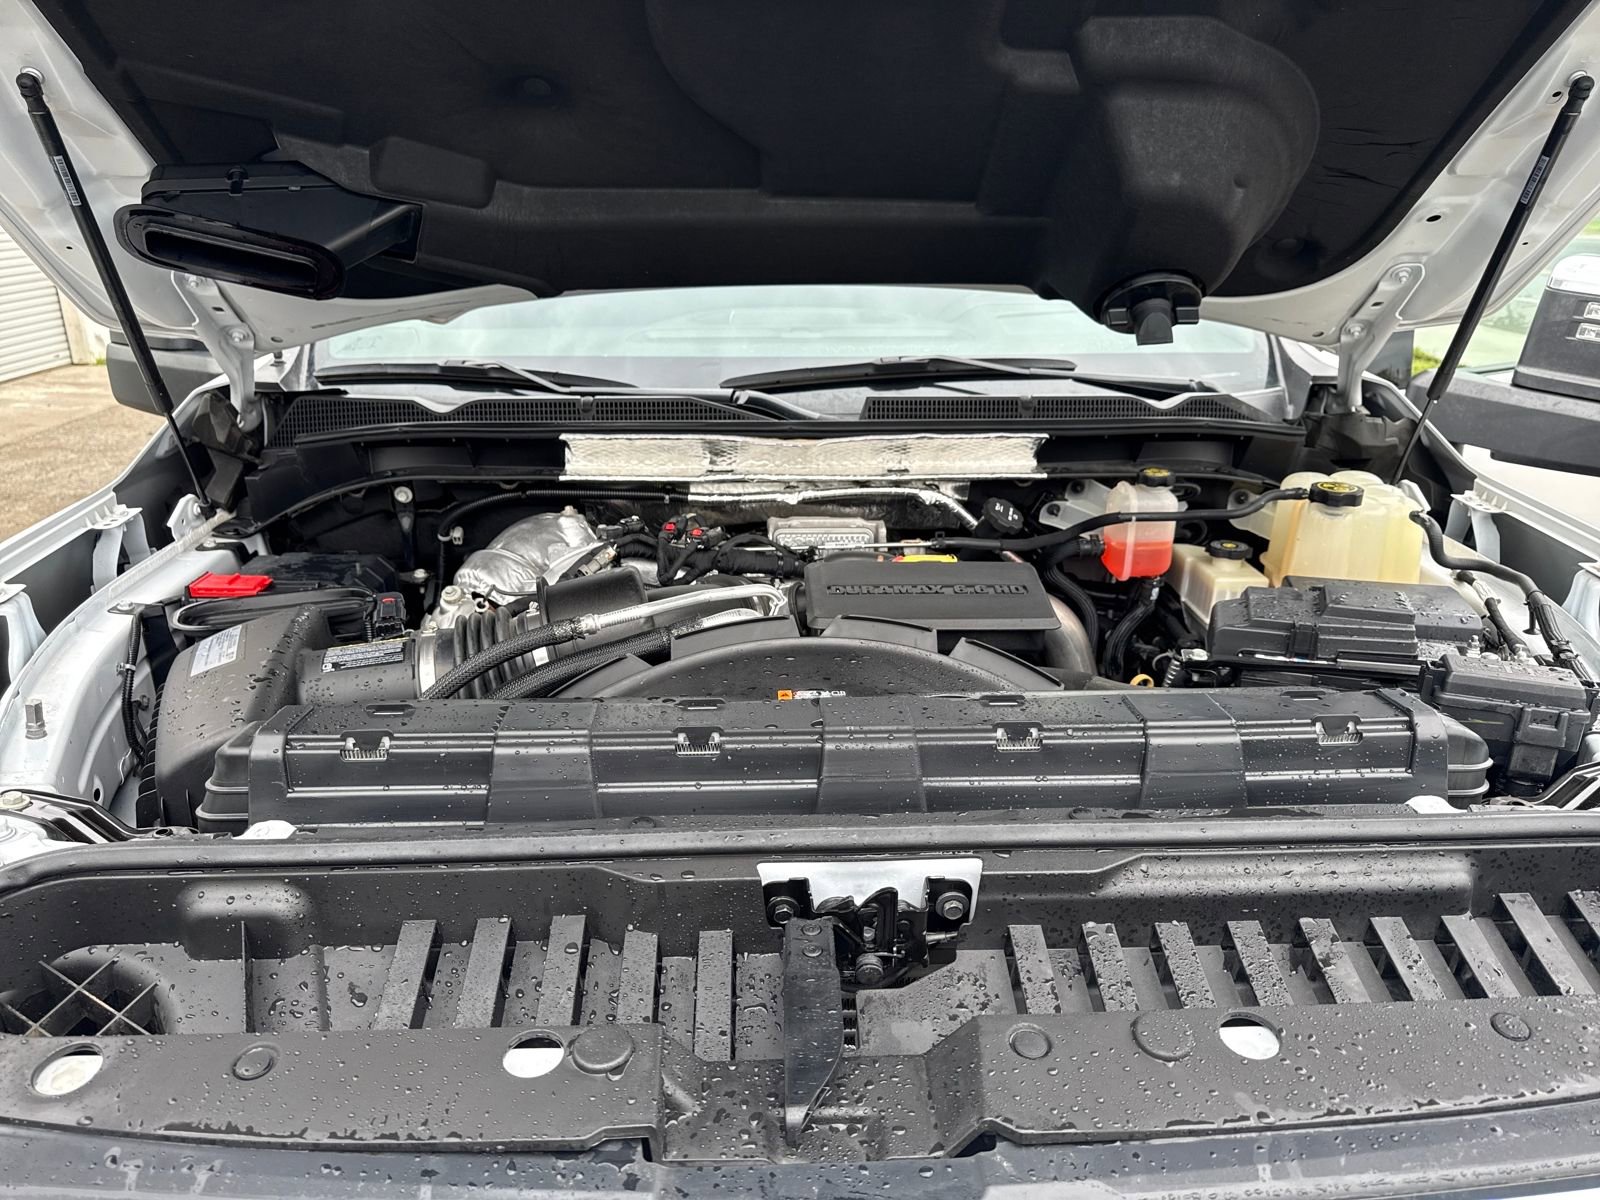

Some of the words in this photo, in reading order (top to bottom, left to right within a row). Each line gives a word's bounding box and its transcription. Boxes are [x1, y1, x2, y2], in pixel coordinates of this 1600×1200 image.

[827, 584, 945, 596] DURAMAX
[953, 584, 989, 595] 6.6
[994, 584, 1028, 595] HD
